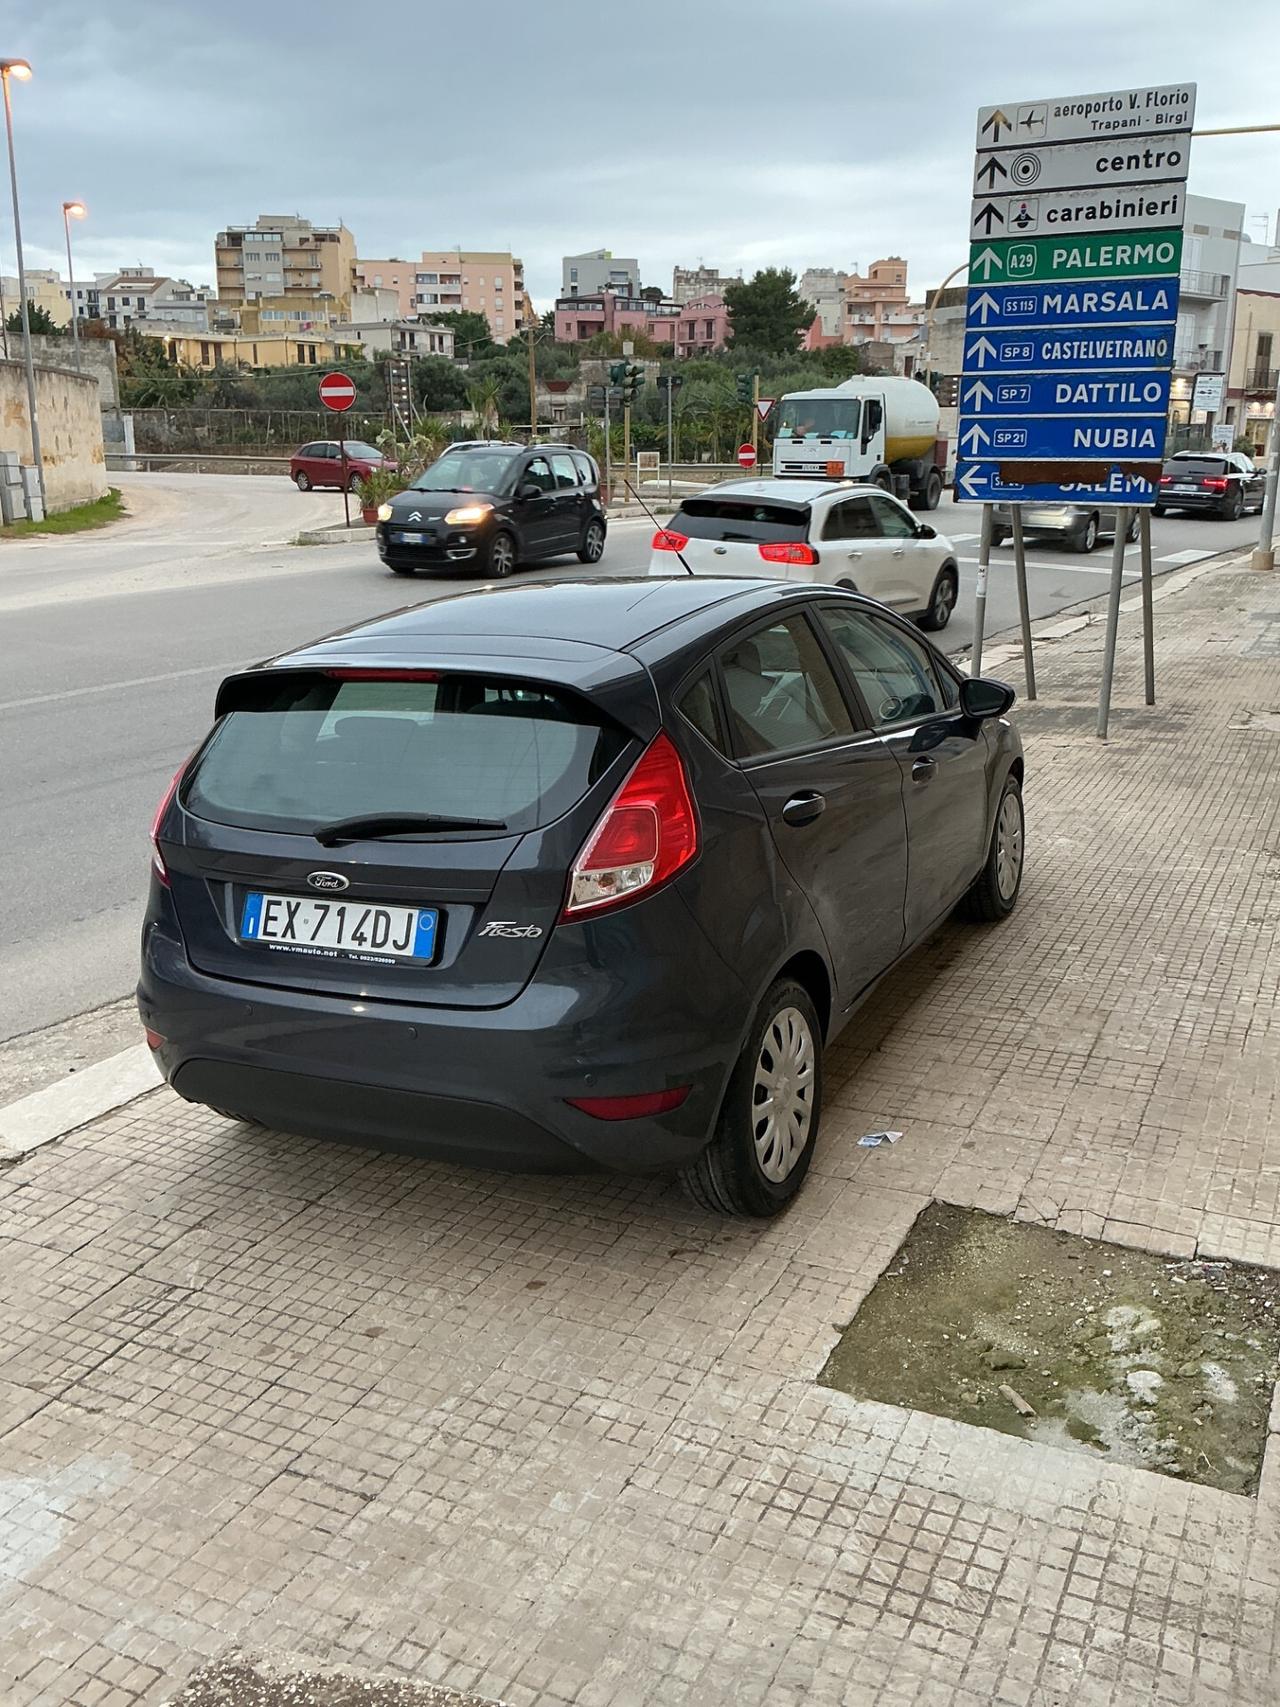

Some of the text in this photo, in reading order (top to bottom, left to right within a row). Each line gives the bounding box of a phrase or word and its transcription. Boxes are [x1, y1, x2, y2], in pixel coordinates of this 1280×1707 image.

[1054, 89, 1189, 119] aeroporto V. Florio
[1091, 116, 1141, 131] Trapani
[1155, 111, 1188, 127] Birgi
[1096, 150, 1182, 173] centro
[1046, 195, 1178, 224] carabinieri
[1010, 242, 1175, 270] A29 PALERMO
[1006, 289, 1169, 314] SS 115 MARSALA
[1004, 339, 1168, 360] SP 8 CASTELVETRANO
[1001, 389, 1018, 400] SP
[1019, 389, 1027, 399] 7
[1055, 382, 1162, 404] DATTILO
[1073, 428, 1156, 448] NUBIA
[315, 875, 338, 888] Ford
[262, 899, 302, 939] EX
[310, 903, 414, 951] 714DJ
[478, 921, 543, 938] Fiesta
[269, 943, 338, 958] www.vmauto.net
